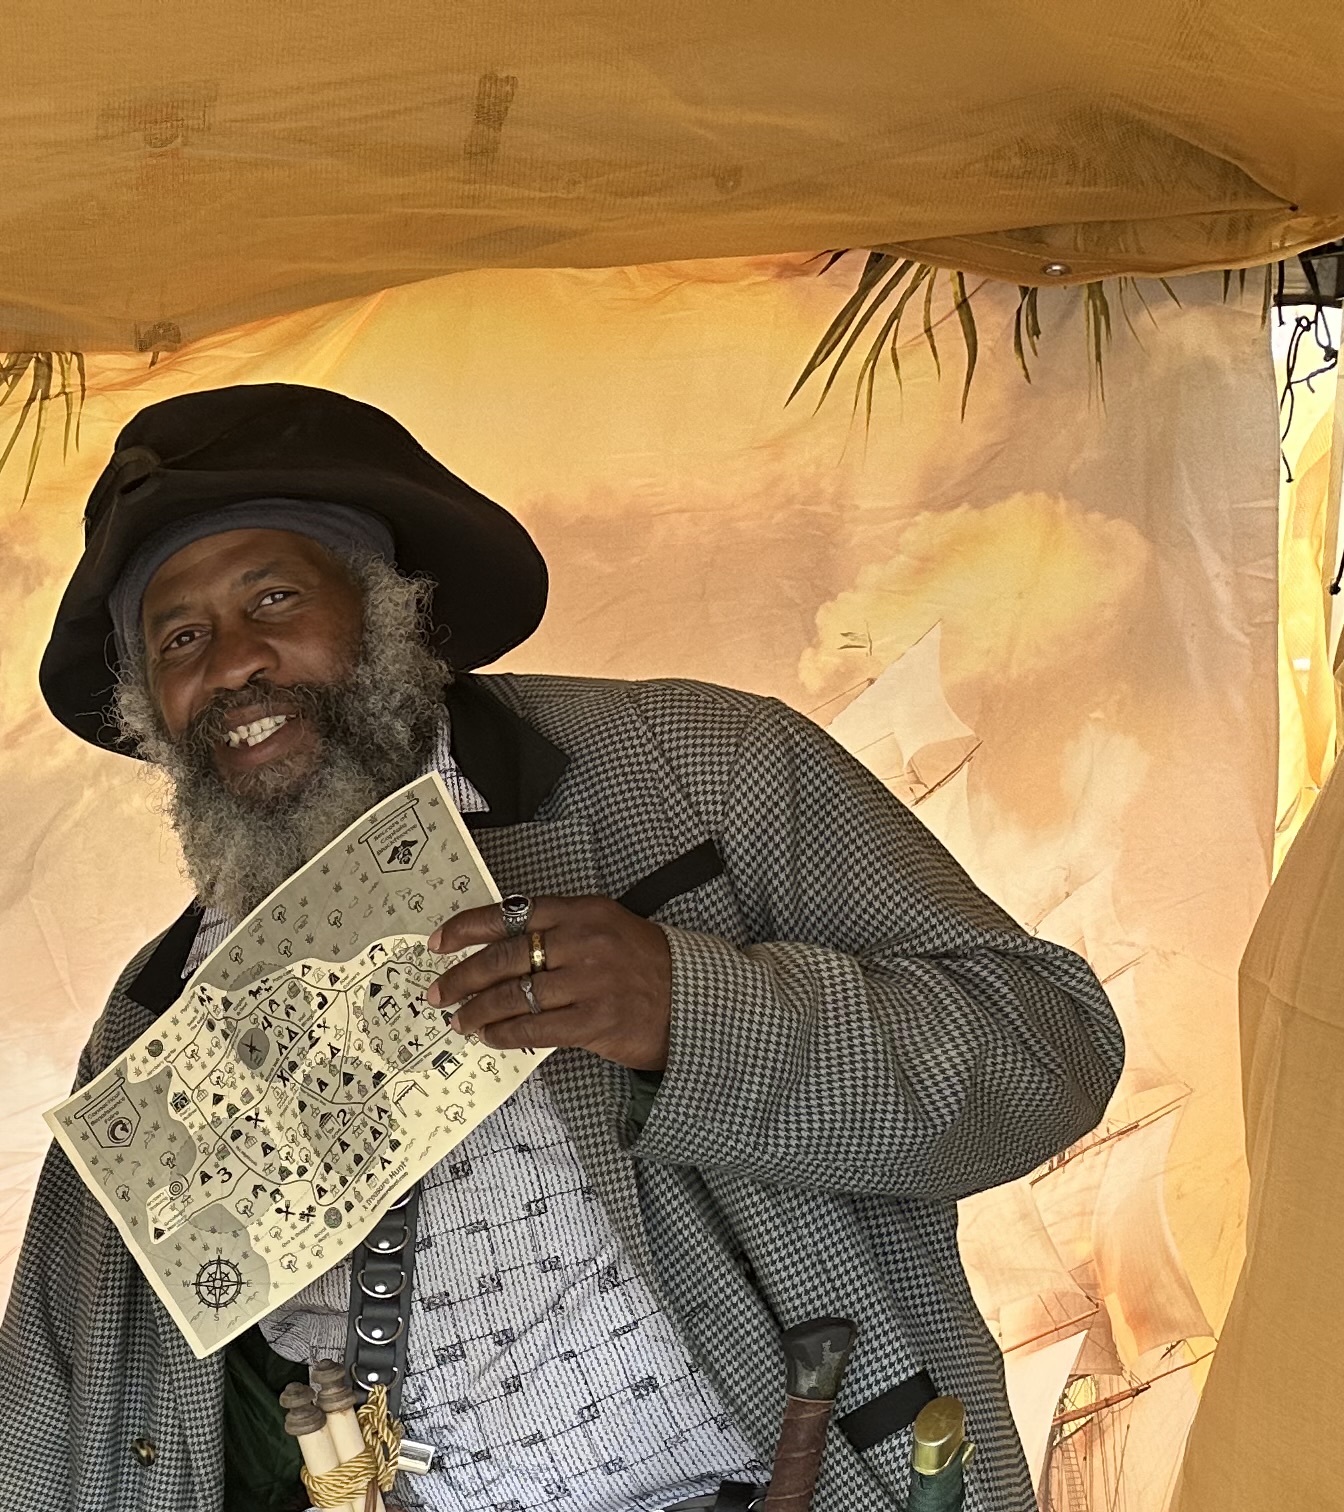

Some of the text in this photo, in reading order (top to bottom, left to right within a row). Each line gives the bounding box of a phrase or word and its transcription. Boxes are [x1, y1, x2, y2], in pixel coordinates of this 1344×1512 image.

[407, 1002, 421, 1018] 1
[261, 1016, 272, 1031] 4
[336, 1109, 351, 1127] 2
[216, 1167, 233, 1184] 3
